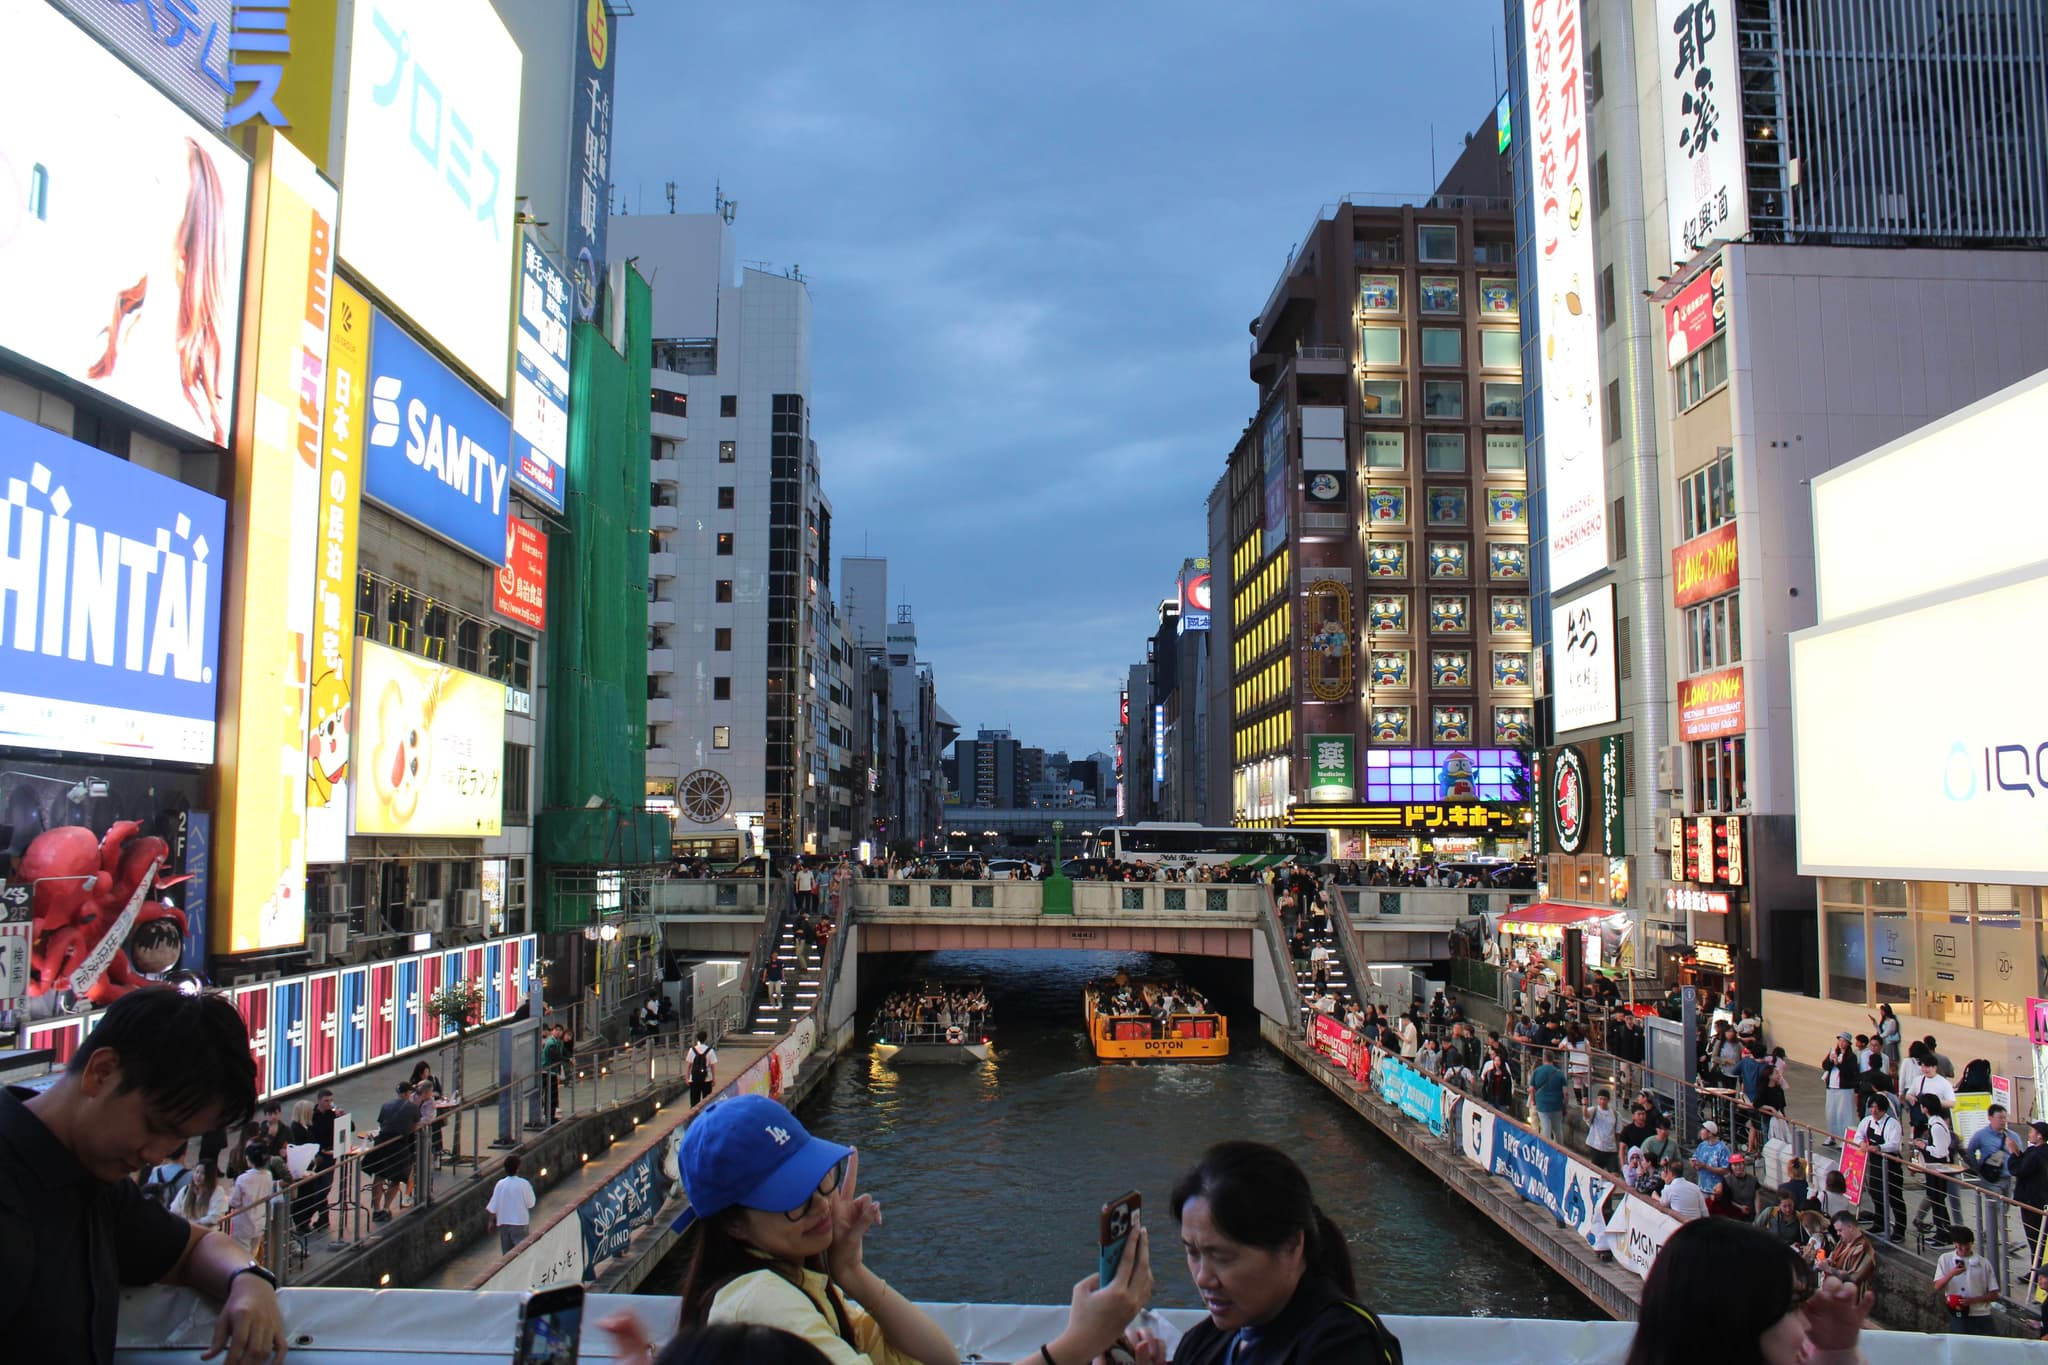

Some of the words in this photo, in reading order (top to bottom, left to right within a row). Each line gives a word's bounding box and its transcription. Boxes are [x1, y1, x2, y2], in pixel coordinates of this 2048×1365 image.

[1556, 0, 1581, 186] ラオケ
[406, 398, 507, 515] SAMTY
[1554, 513, 1602, 552] MANEKINEKO
[1677, 553, 1705, 594] LONG
[1708, 538, 1737, 578] DINH
[1682, 682, 1709, 708] LONG
[1711, 676, 1740, 702] DINH
[1317, 742, 1345, 769] 薬
[1728, 818, 1742, 884] 串かつ
[1144, 1040, 1184, 1050] DOTON
[765, 1125, 792, 1146] LA
